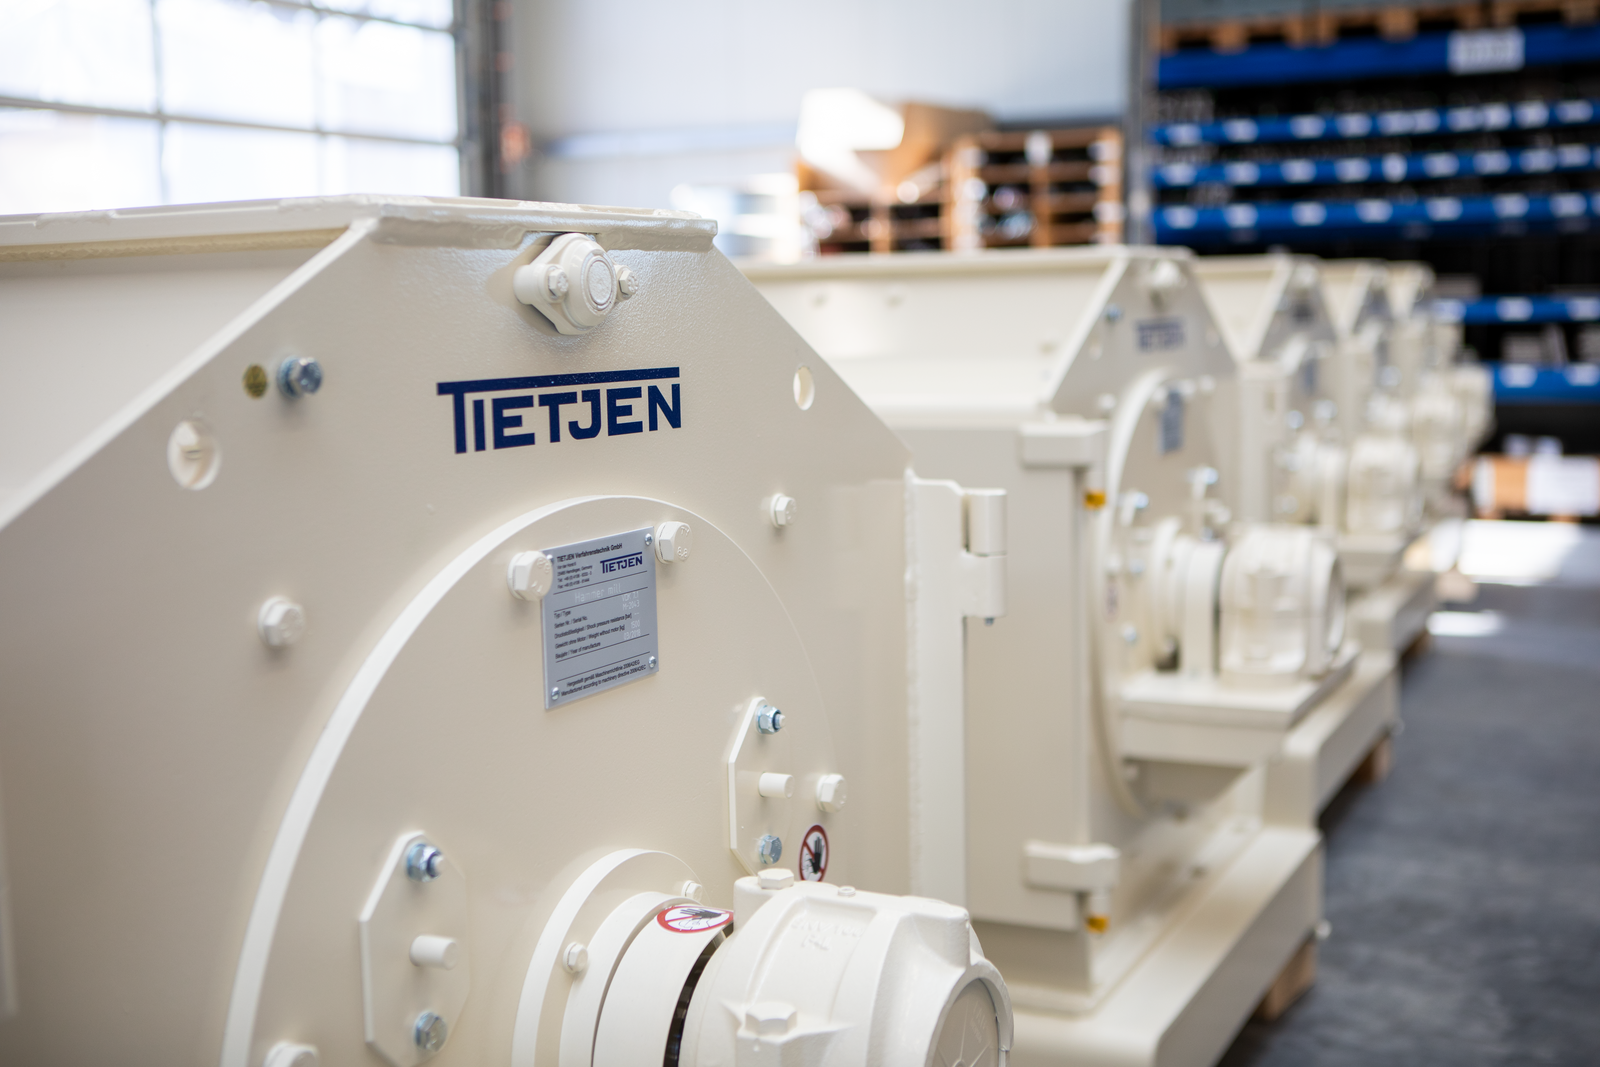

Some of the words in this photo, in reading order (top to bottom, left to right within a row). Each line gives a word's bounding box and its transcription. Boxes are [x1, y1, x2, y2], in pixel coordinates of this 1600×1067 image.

[437, 367, 681, 454] TIETJEN
[557, 553, 574, 562] TIETJEN
[575, 546, 610, 558] Verfahrenstechnik
[600, 551, 642, 574] TIETJEN
[575, 589, 604, 603] Hammer
[608, 583, 622, 595] mill
